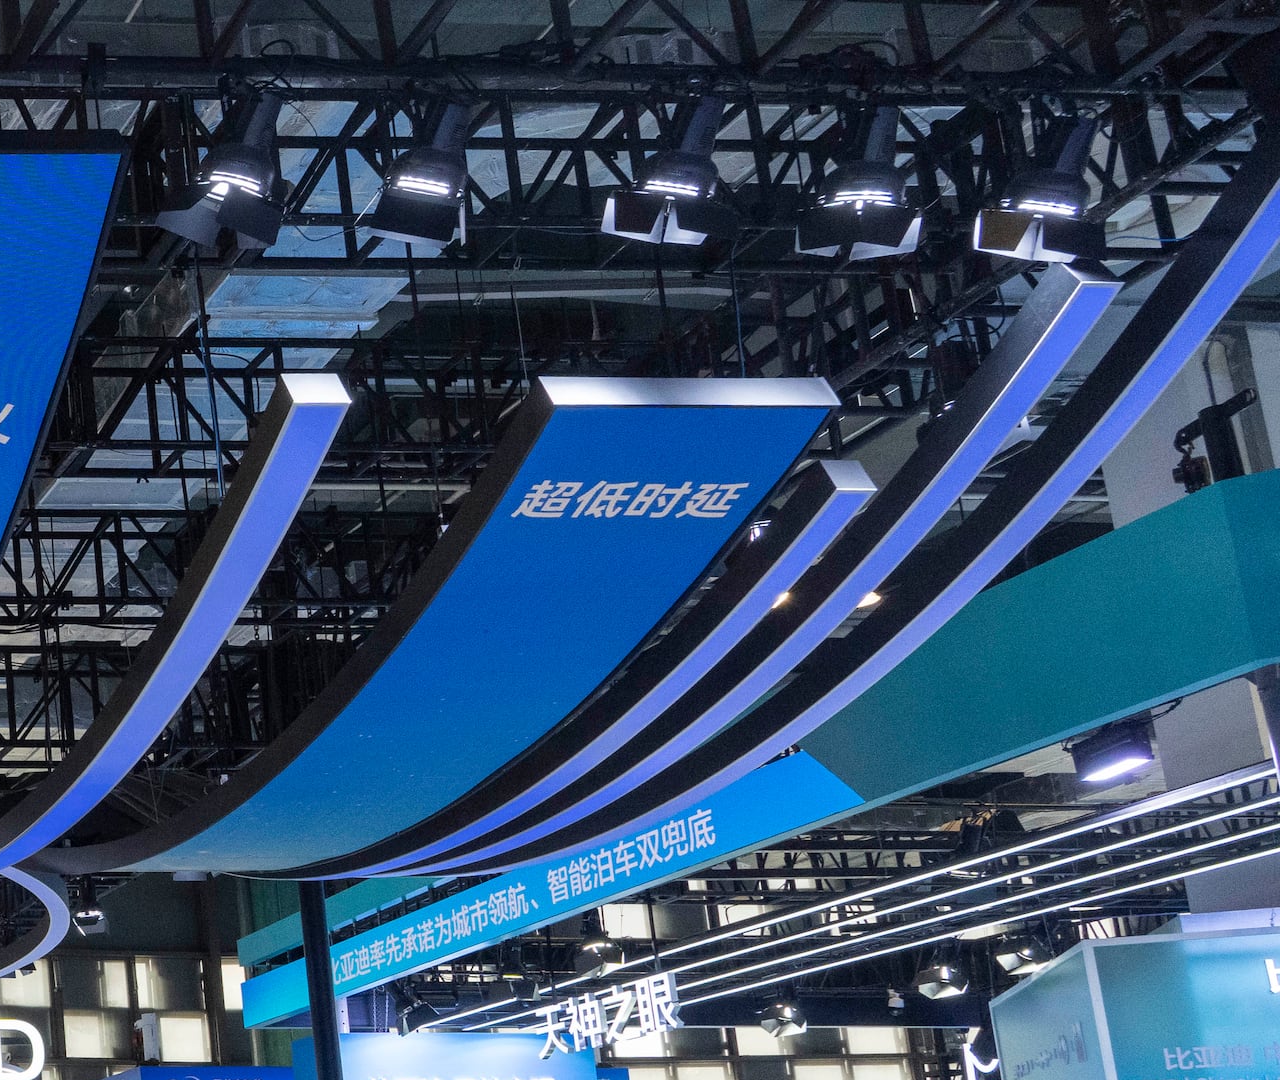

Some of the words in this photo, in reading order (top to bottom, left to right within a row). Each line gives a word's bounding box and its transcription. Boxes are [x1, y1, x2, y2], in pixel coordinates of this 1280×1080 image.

[511, 479, 749, 518] 超低时延
[536, 973, 684, 1060] 天神之眼
